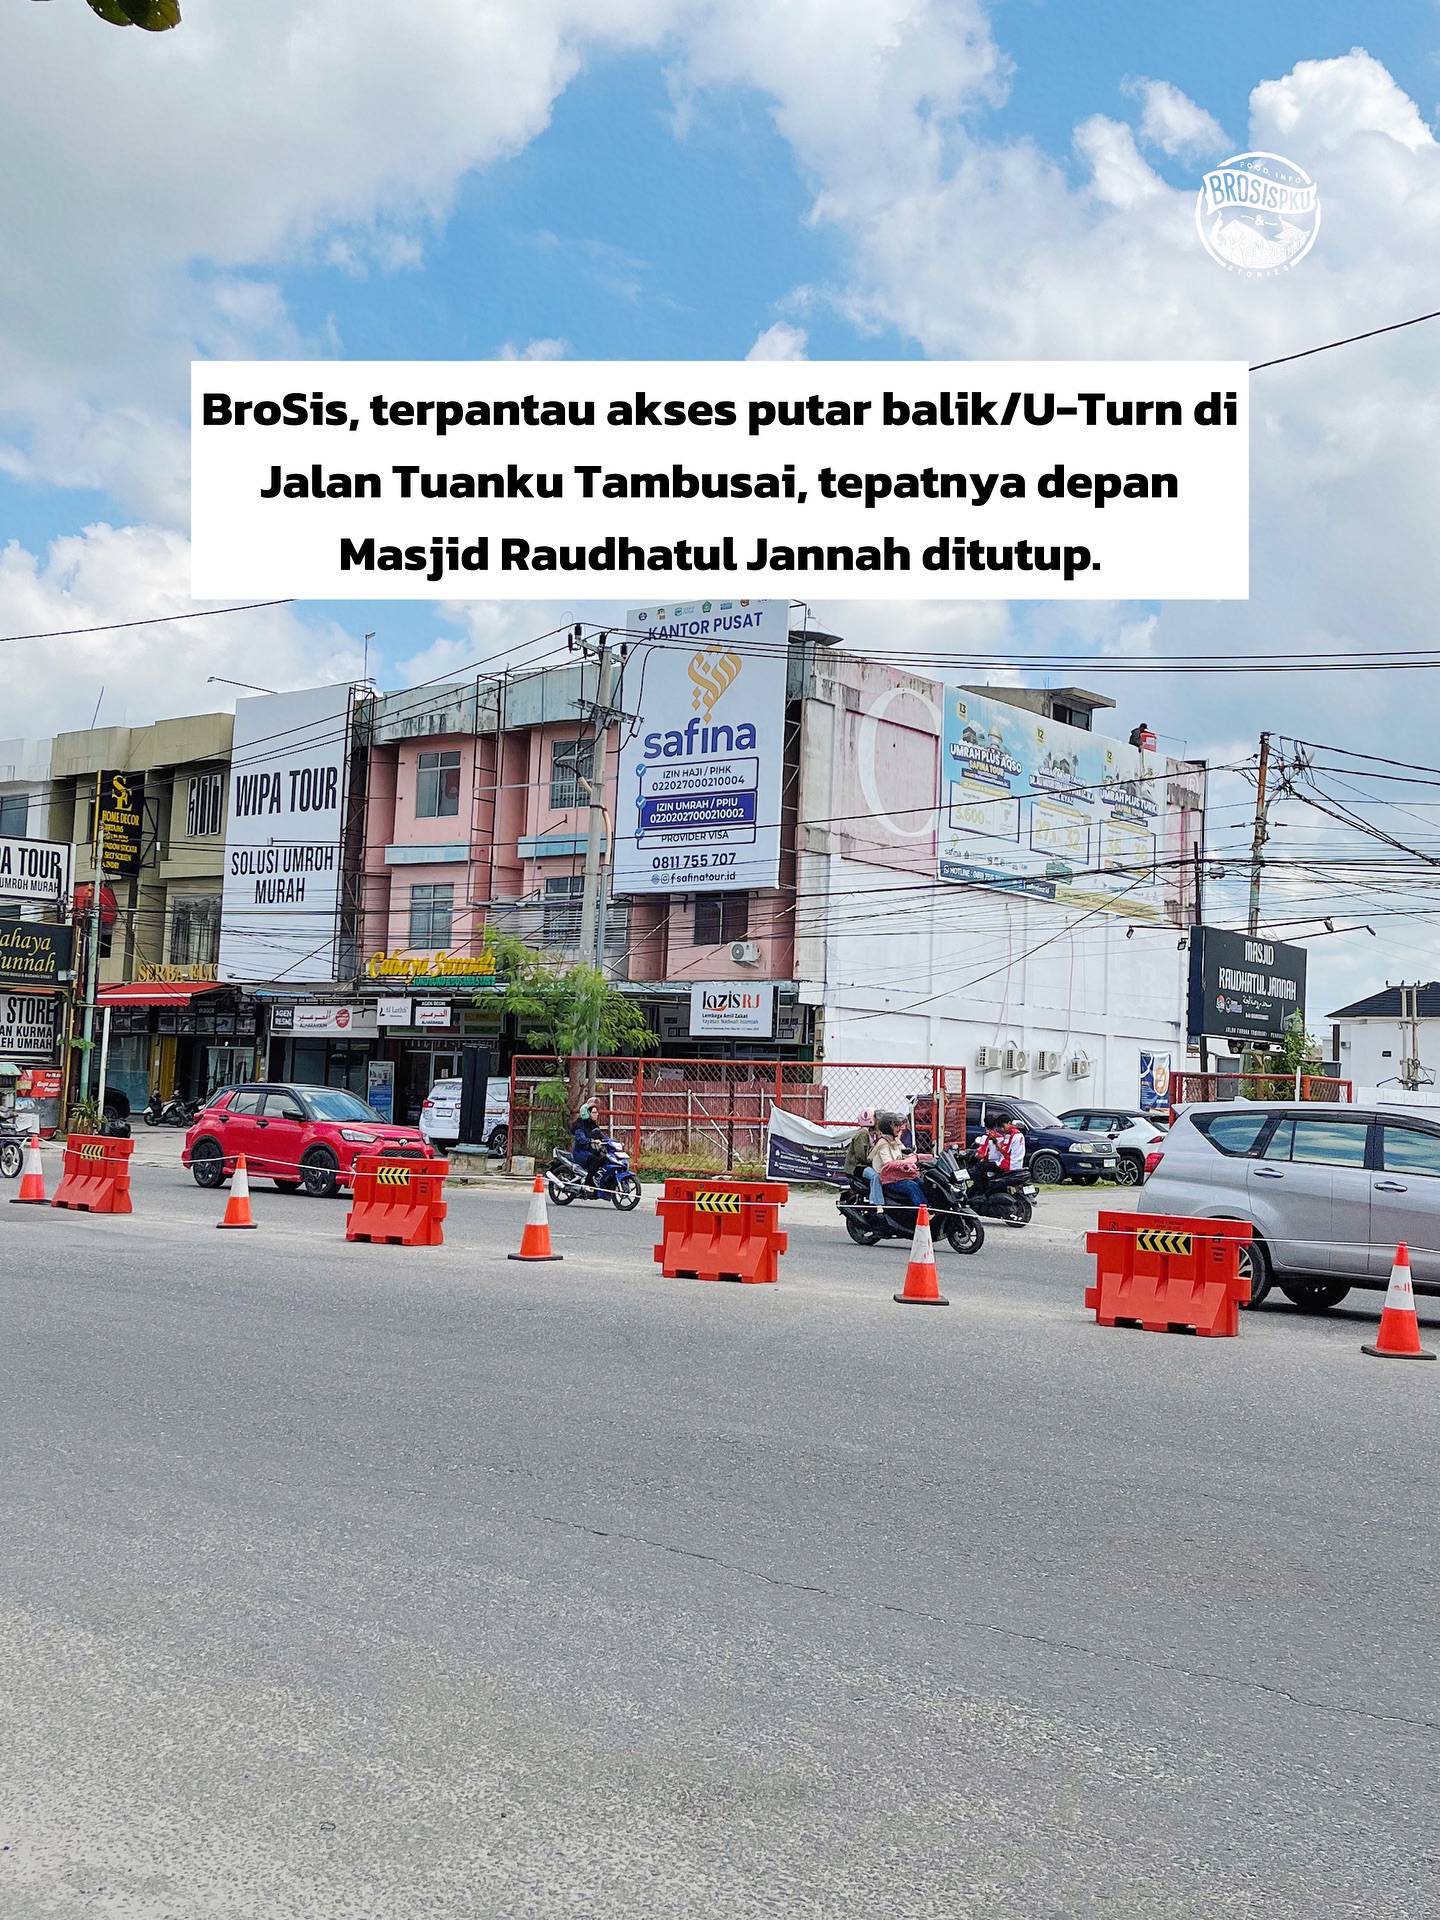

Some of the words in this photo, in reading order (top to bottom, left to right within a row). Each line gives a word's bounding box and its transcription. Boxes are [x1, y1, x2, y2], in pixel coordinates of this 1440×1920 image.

[648, 619, 709, 641] KANTOR
[713, 611, 763, 632] PUSAT
[643, 717, 757, 759] safina
[950, 743, 980, 761] UMRAH
[981, 748, 1000, 766] PLUS
[1001, 755, 1022, 774] AQSO
[989, 764, 1005, 777] TOUR
[663, 769, 680, 779] IZIN
[682, 768, 702, 778] HAJI
[709, 765, 732, 775] PIHK
[236, 772, 281, 817] WIPA
[289, 766, 338, 813] TOUR
[657, 802, 674, 812] IZIN
[675, 799, 709, 811] UMRAH
[716, 797, 738, 807] PPIU
[102, 810, 120, 823] HOME
[120, 813, 140, 826] DECOR
[661, 831, 706, 843] PROVIDER
[708, 830, 729, 840] VISA
[18, 847, 61, 879] TOUR
[231, 848, 279, 876] SOLUSI
[283, 846, 334, 873] UMROH
[652, 855, 680, 869] 0811
[683, 854, 708, 868] 755
[712, 852, 736, 866] 707
[0, 876, 28, 890] UMROH
[31, 880, 59, 893] MURAH
[255, 877, 305, 904] MURAH
[0, 927, 52, 956] ahaya
[1244, 940, 1274, 966] MASJID
[0, 951, 56, 973] unnah
[1218, 966, 1267, 996] RAUDHATUL
[1267, 975, 1297, 1001] JANNAH
[7, 996, 54, 1025] STORE
[1, 1037, 13, 1048] EH
[17, 1038, 52, 1049] UMRAH
[16, 1026, 52, 1038] KURMA
